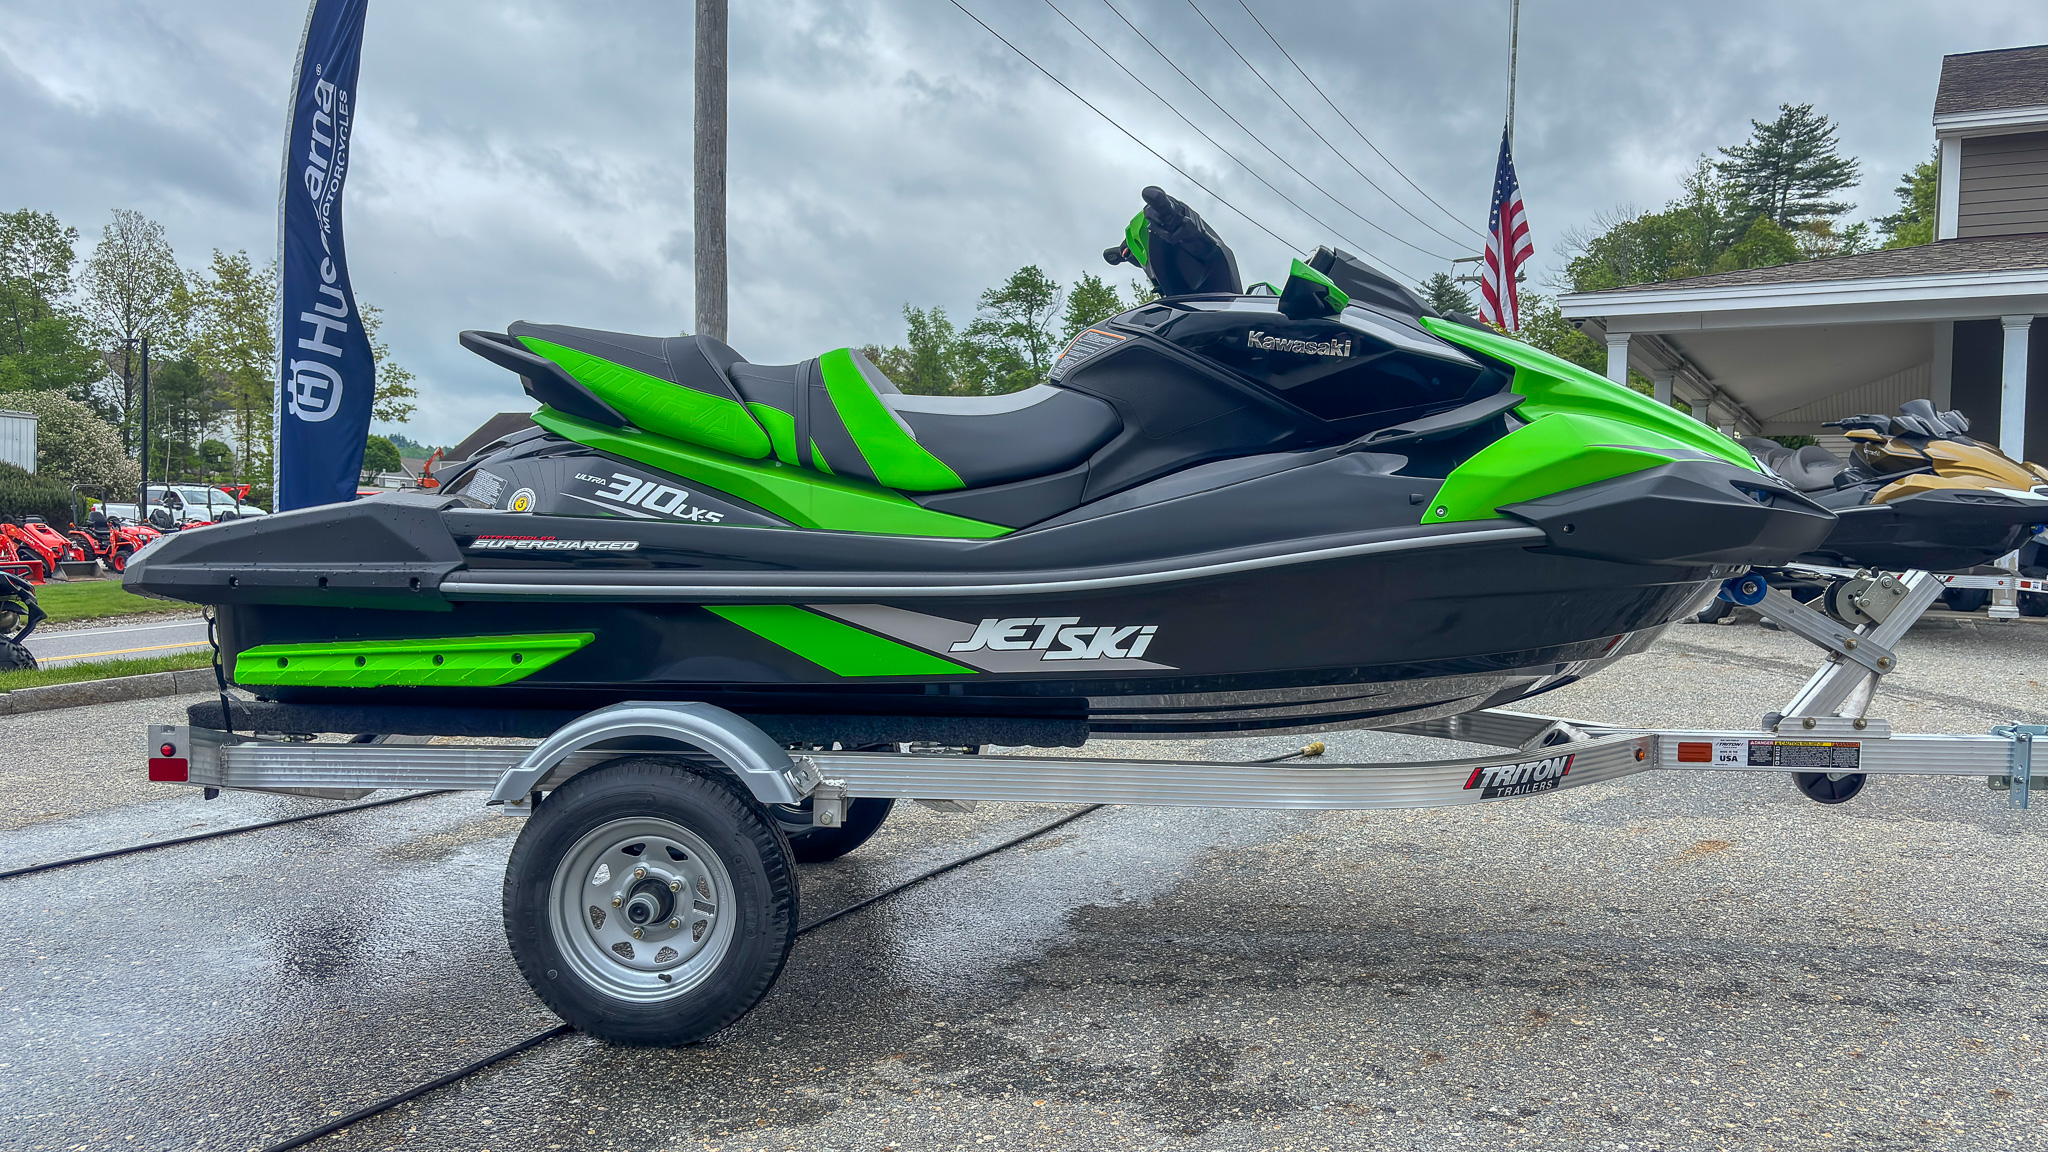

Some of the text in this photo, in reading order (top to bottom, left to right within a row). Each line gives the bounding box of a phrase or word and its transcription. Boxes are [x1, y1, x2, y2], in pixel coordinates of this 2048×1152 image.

[322, 89, 350, 234] MOTORCYCLES
[298, 78, 349, 357] Husarna
[1247, 330, 1352, 357] Kawasaki
[517, 499, 526, 509] 3
[574, 472, 607, 486] ULTRA
[594, 472, 690, 514] 310
[469, 540, 640, 551] SUPERCHARGED
[1480, 756, 1568, 788] TRITON
[1497, 780, 1553, 797] TRAILERS
